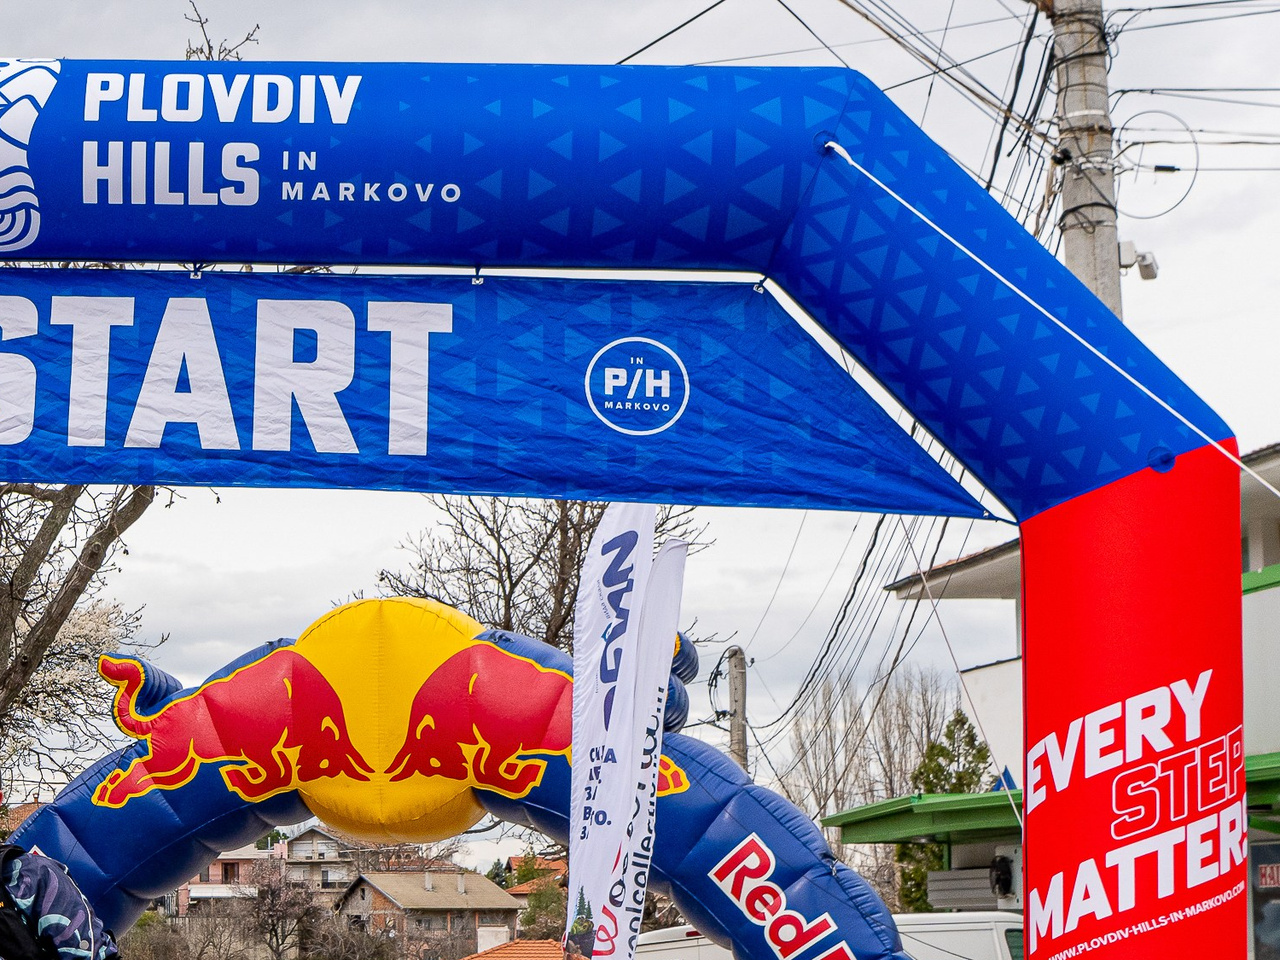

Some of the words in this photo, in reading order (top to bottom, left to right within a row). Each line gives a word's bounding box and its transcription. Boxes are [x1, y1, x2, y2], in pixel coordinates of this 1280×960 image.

[83, 72, 363, 125] PLOVDIV
[82, 141, 261, 207] HILLS
[282, 151, 317, 171] IN
[281, 182, 461, 203] MARKOVO
[630, 356, 644, 365] IN
[604, 367, 671, 399] P/H
[604, 401, 670, 412] MARKOVO
[1027, 668, 1213, 815] EVERY
[1111, 724, 1245, 840] STEP
